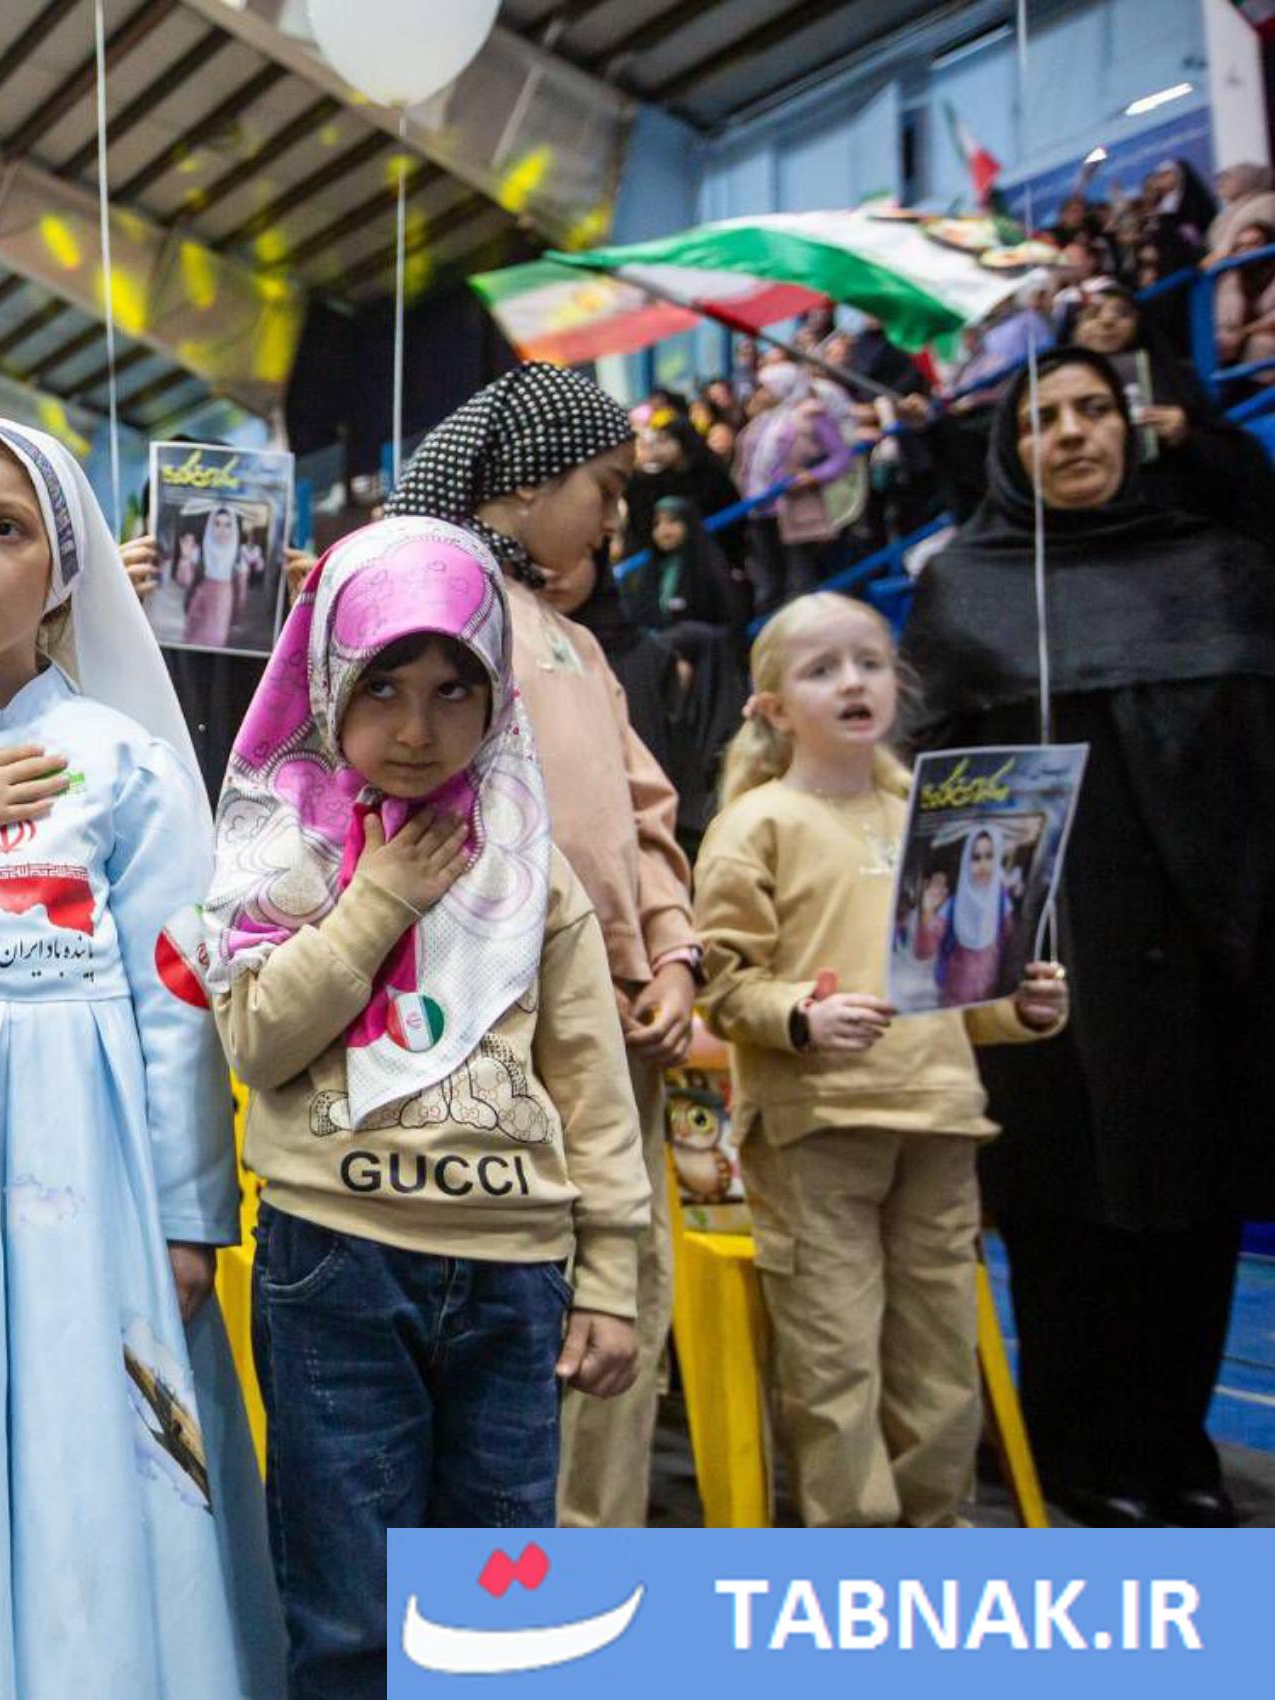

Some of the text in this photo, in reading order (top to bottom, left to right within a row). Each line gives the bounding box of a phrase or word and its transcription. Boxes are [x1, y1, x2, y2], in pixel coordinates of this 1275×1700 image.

[46, 939, 64, 978] باد
[64, 935, 94, 982] پاینده
[340, 1151, 529, 1196] GUCCI
